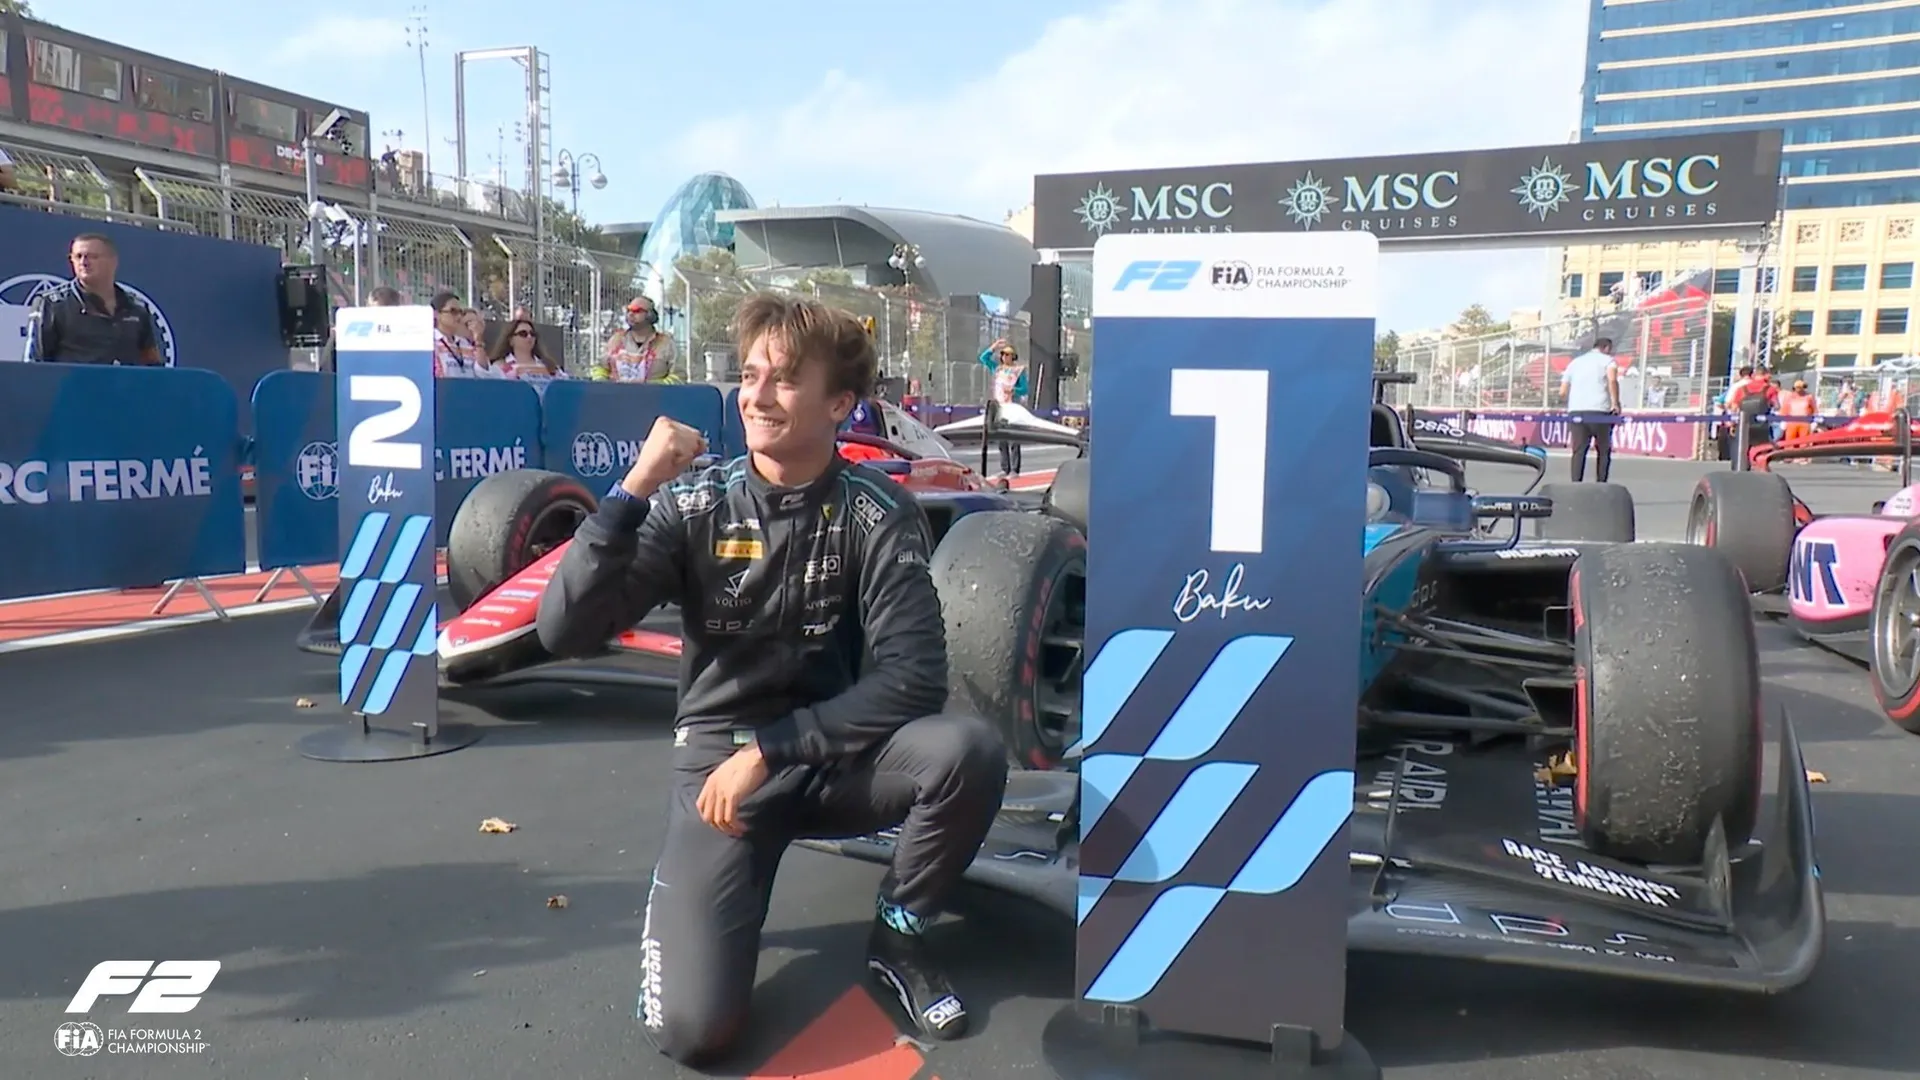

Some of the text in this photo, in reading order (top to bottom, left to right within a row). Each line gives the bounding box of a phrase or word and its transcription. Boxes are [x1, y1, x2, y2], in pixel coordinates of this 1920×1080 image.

[1342, 170, 1459, 212] MSC
[1584, 154, 1720, 201] MSC
[1130, 182, 1233, 221] MSC
[1582, 202, 1718, 222] CRUISES
[1341, 215, 1458, 231] CRUISES
[1112, 260, 1202, 291] F2
[1257, 266, 1345, 276] FIA FORMULA 2
[349, 375, 422, 469] 2
[68, 444, 212, 502] FERMÉ
[452, 437, 525, 479] FERMÉ
[1170, 368, 1269, 553] 1
[367, 472, 403, 504] Baku
[854, 494, 885, 524] OMP
[1173, 563, 1271, 622] Baku
[1502, 838, 1681, 900] RACE AGAINST
[649, 938, 663, 996] LUCAS
[928, 999, 962, 1024] OMP
